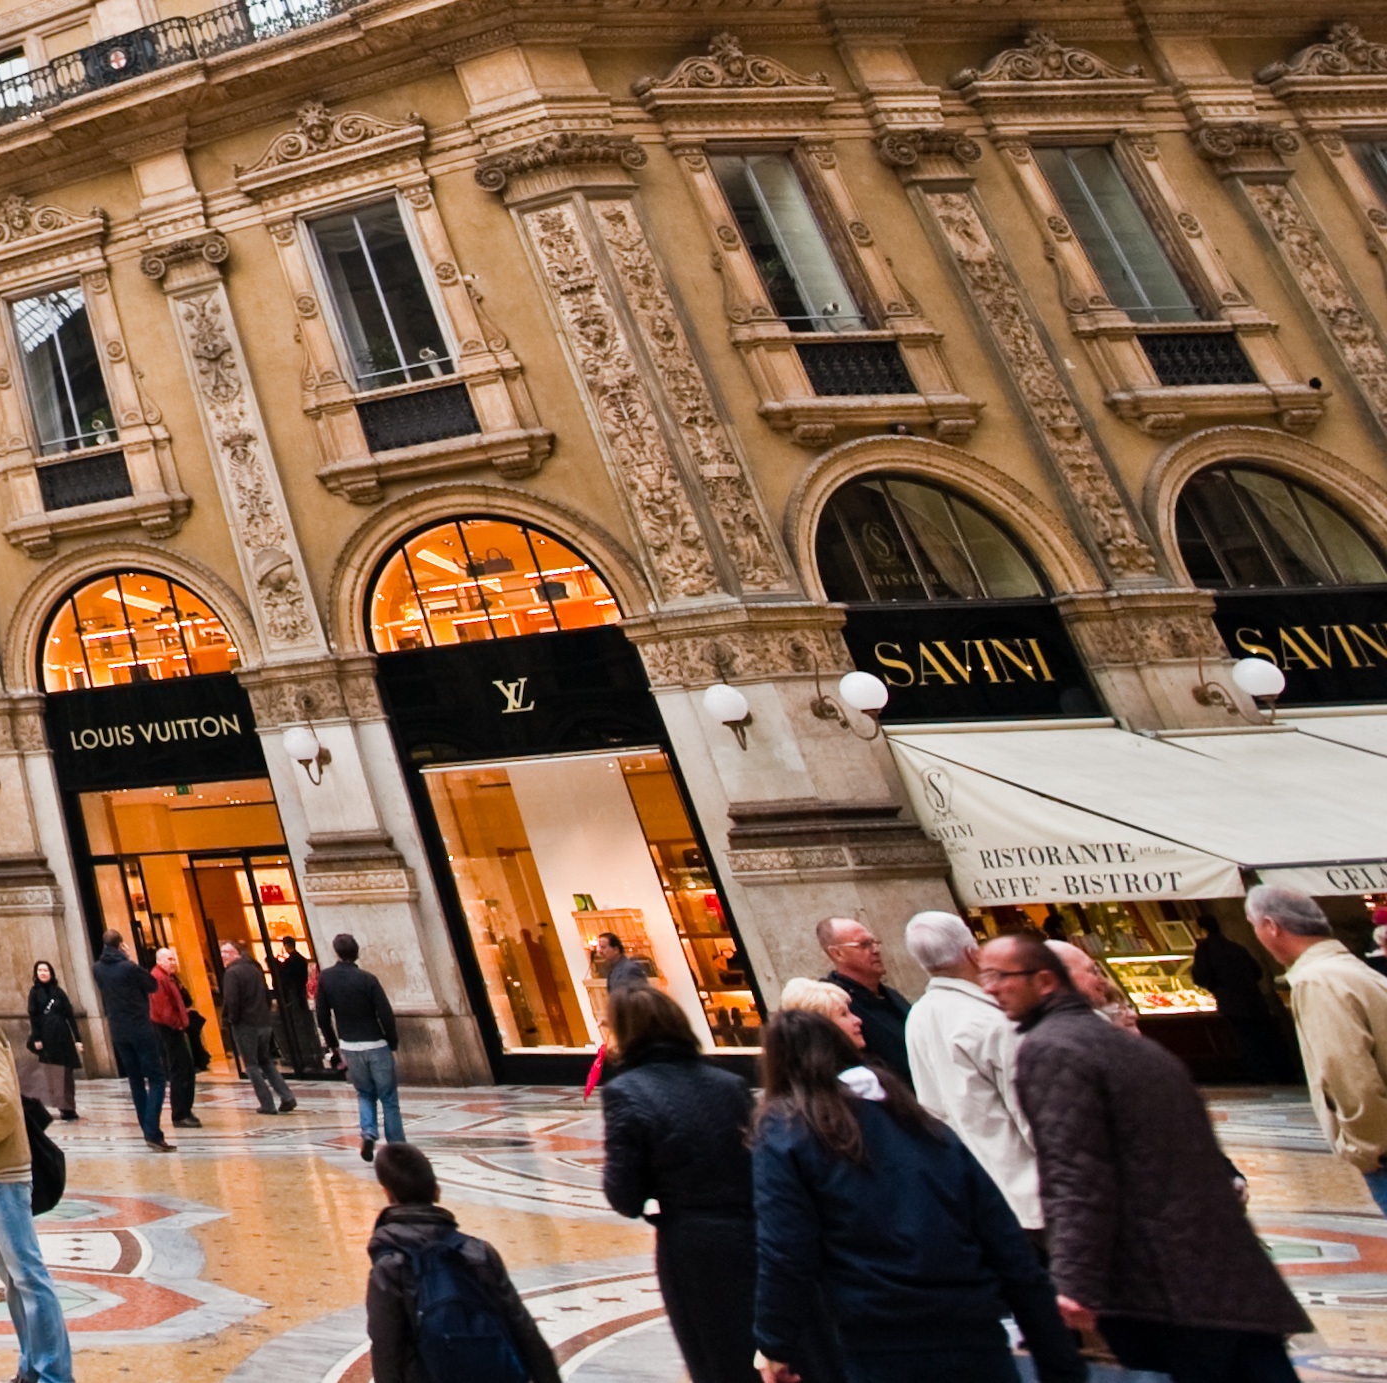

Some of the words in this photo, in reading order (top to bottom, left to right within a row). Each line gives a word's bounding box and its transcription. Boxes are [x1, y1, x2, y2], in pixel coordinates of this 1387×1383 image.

[874, 638, 1056, 687] SAVINI
[1235, 623, 1387, 670] SAVIN
[70, 724, 135, 751] LOUIS
[138, 714, 242, 744] VUITTON
[978, 842, 1136, 869] RISTORANTE
[973, 876, 1041, 900] CAFFE'
[1062, 871, 1183, 896] BISTROT
